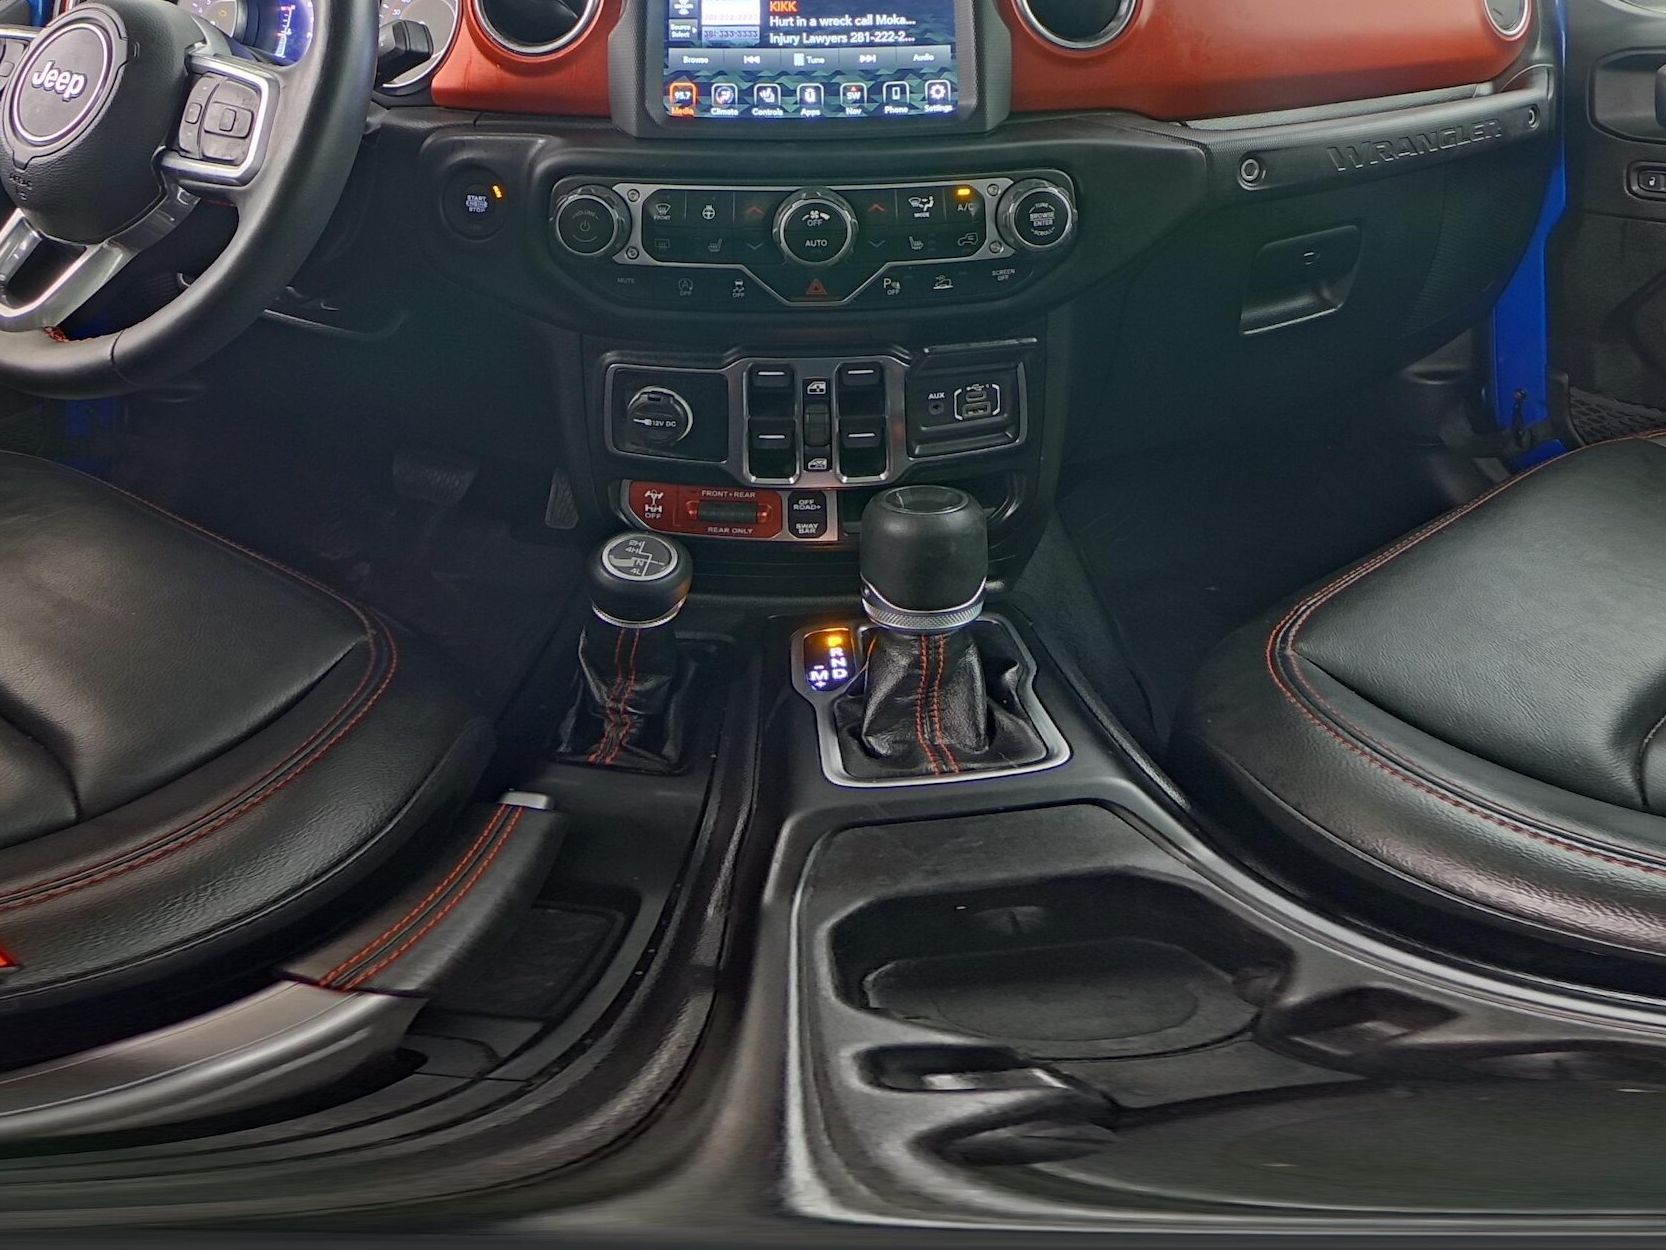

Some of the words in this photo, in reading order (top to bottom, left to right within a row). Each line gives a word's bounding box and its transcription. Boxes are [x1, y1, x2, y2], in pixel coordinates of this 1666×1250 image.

[769, 0, 797, 12] KIKK
[769, 16, 795, 27] Hurt
[797, 16, 806, 26] in
[809, 18, 817, 26] a
[820, 14, 852, 26] wreck
[855, 14, 873, 26] call
[875, 14, 916, 26] Moka...
[769, 32, 800, 46] Injury
[803, 32, 847, 46] Lawyers
[683, 56, 709, 64] Browse
[807, 56, 825, 64] Tune
[913, 54, 935, 62] Audio
[31, 59, 87, 102] Jeep
[674, 92, 691, 100] 95.7
[847, 91, 861, 100] SW
[671, 106, 694, 115] Media
[711, 108, 739, 116] Climate
[752, 108, 783, 116] Controls
[801, 108, 821, 118] Apps
[845, 107, 862, 115] Nav
[885, 106, 909, 114] Phone
[925, 104, 953, 114] Settings
[1327, 118, 1502, 172] WRANGLER
[957, 204, 975, 212] A/C
[807, 219, 823, 227] OFF
[992, 268, 1015, 276] SCREEN
[887, 288, 900, 296] OFF
[928, 392, 945, 400] AUX
[707, 526, 729, 534] REAR
[625, 546, 639, 554] 4H
[829, 646, 844, 658] R
[831, 657, 847, 668] N
[809, 670, 829, 681] M
[831, 668, 848, 680] D
